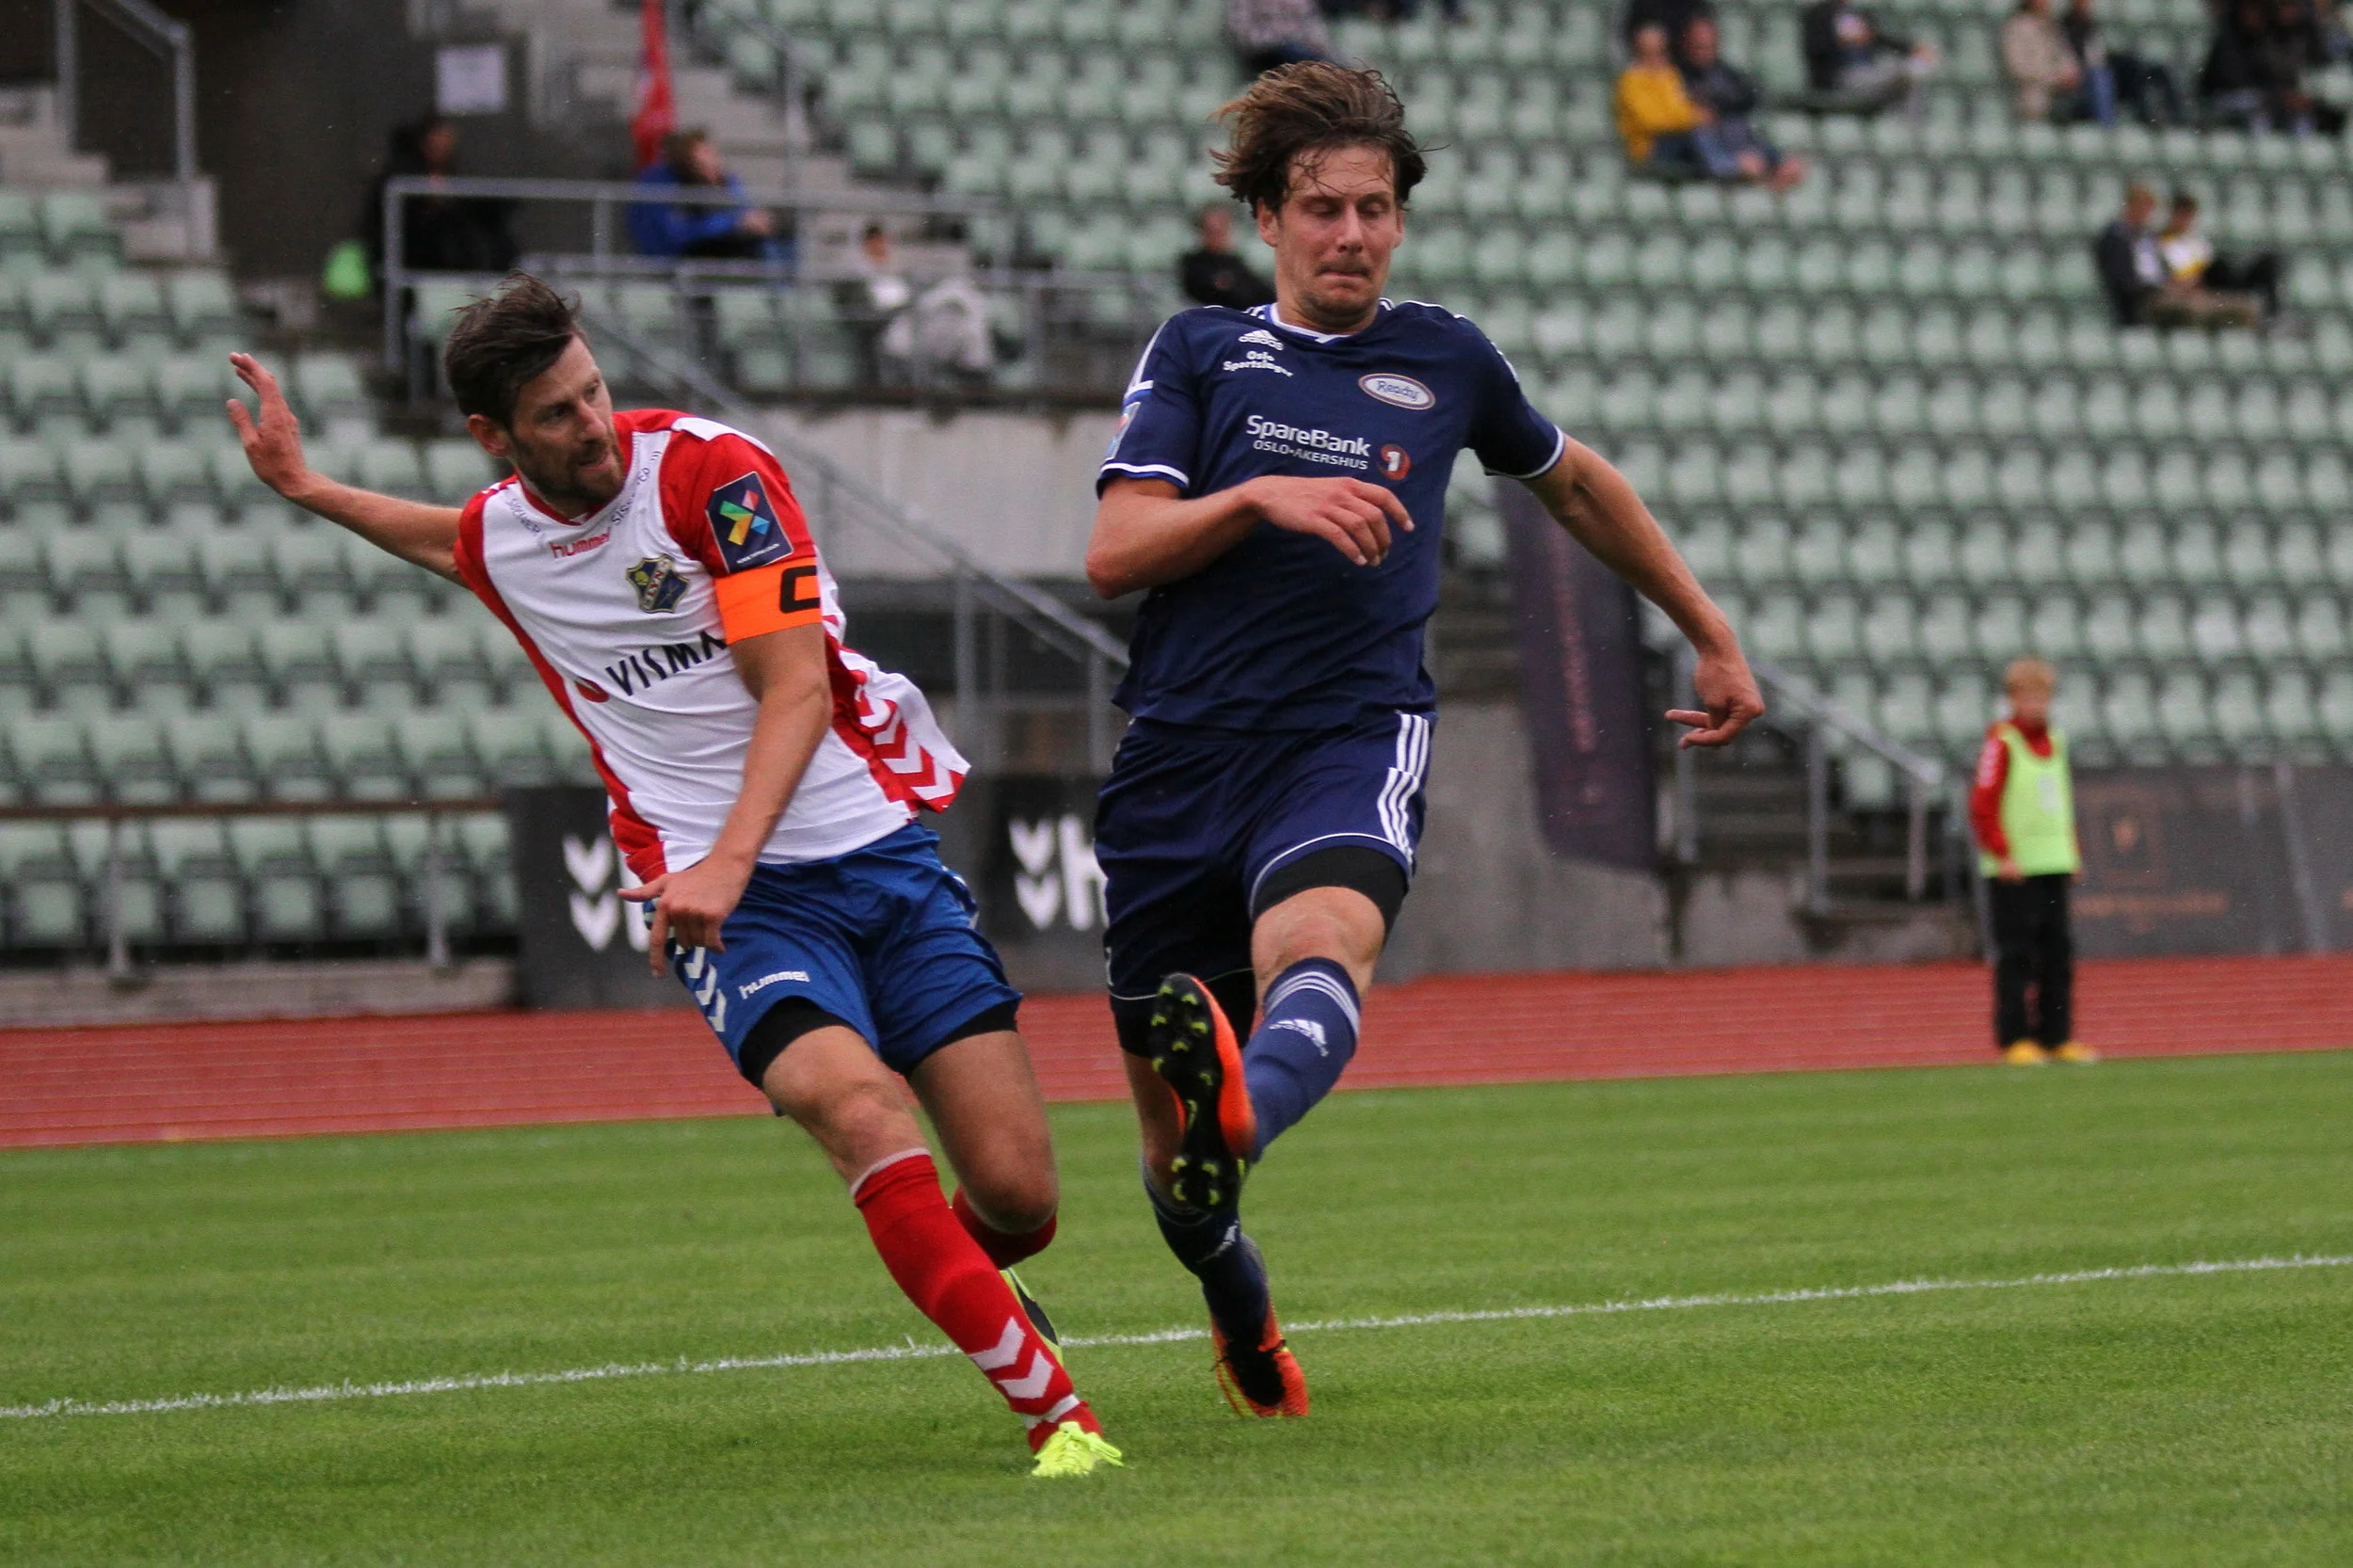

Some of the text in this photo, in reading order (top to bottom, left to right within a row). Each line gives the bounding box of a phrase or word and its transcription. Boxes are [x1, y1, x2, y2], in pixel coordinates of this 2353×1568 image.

[1246, 350, 1275, 361] Oslo
[1377, 380, 1420, 403] Ready
[1245, 414, 1371, 457] SpareBank
[549, 526, 611, 559] hummel
[779, 565, 821, 614] C
[738, 969, 810, 1000] hummel
